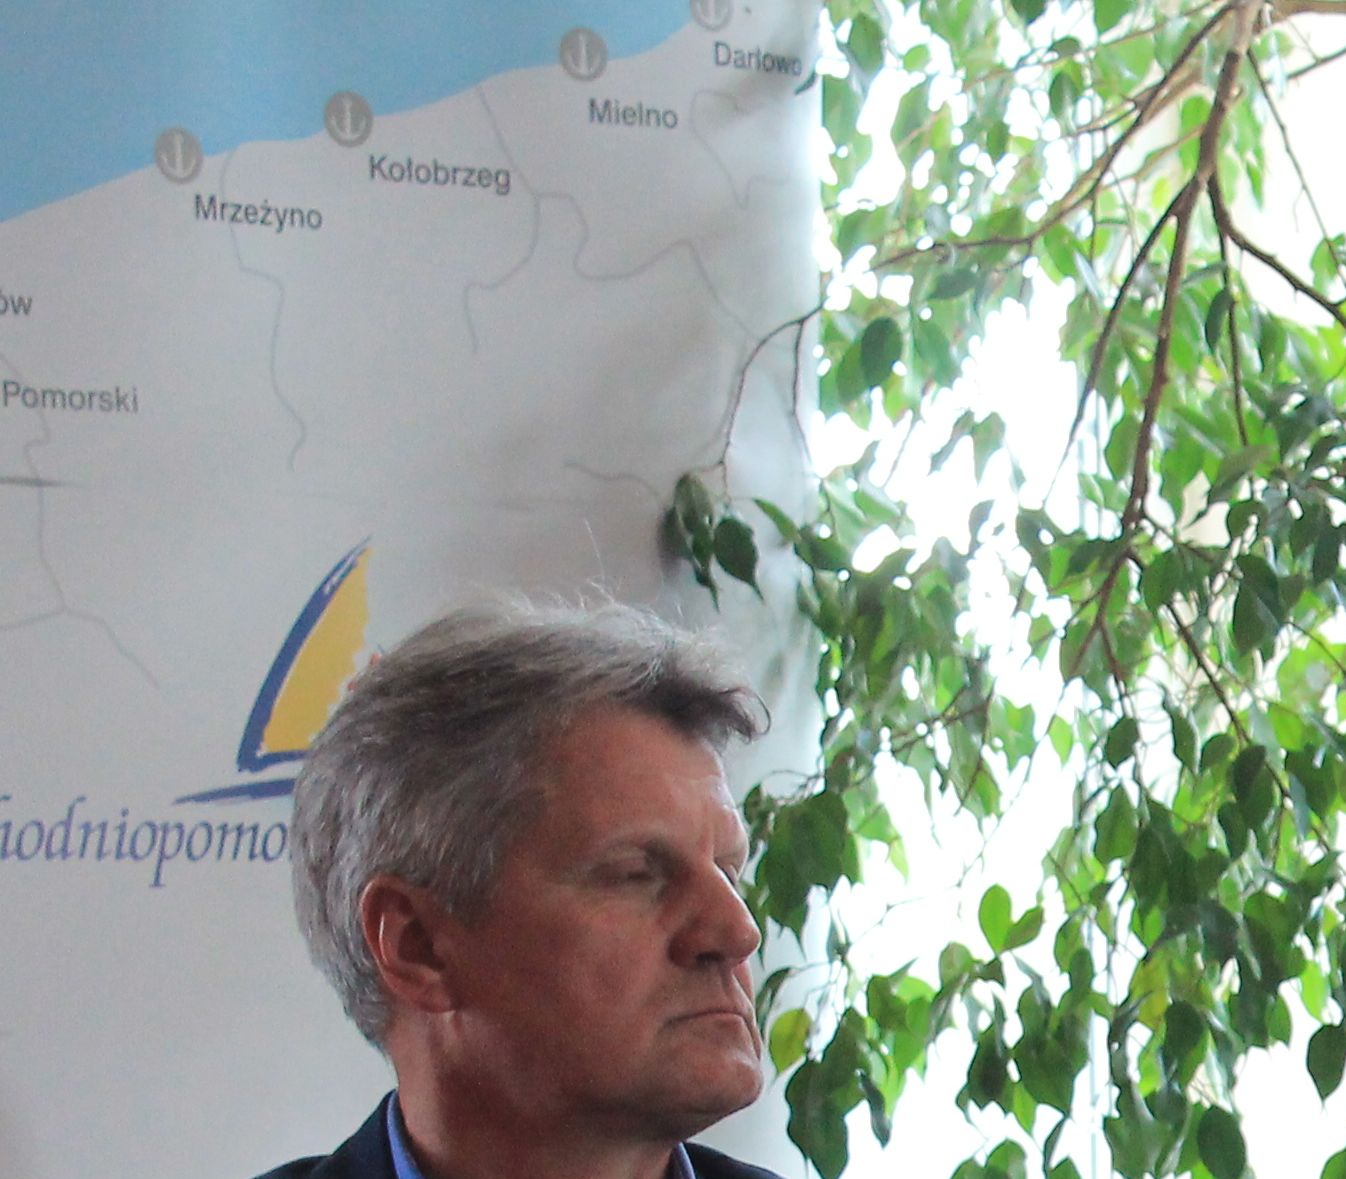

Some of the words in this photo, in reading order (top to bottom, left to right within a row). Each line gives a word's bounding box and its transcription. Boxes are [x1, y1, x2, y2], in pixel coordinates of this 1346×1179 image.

[588, 98, 679, 129] Mielno
[194, 195, 324, 233] Mrzeżyno
[3, 380, 139, 413] Pomorski
[0, 795, 293, 888] odniopomo
